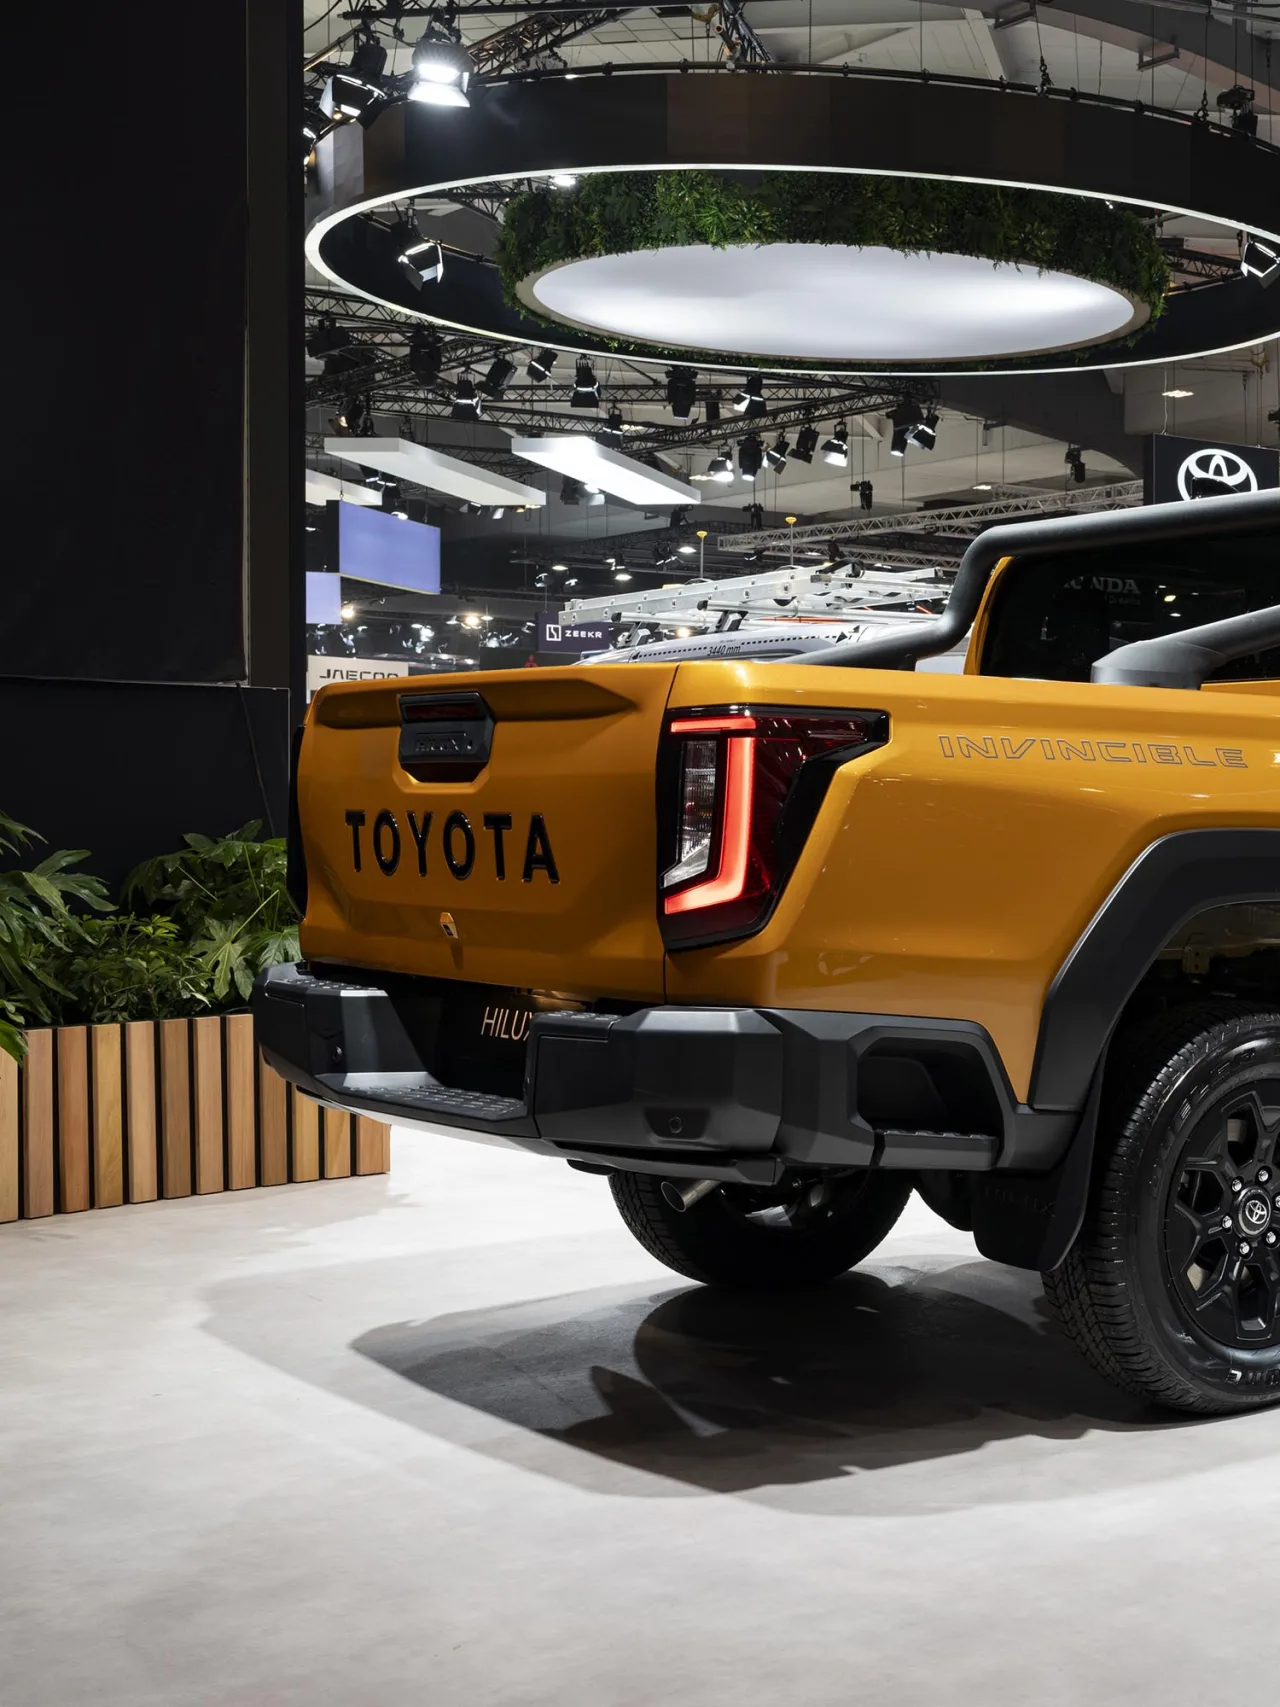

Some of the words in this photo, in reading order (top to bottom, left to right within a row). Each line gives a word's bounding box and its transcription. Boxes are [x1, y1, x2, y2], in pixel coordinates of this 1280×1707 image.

[565, 630, 603, 638] ZEEKR
[938, 735, 1249, 768] INVINCIBLE
[345, 809, 561, 884] TOYOTA
